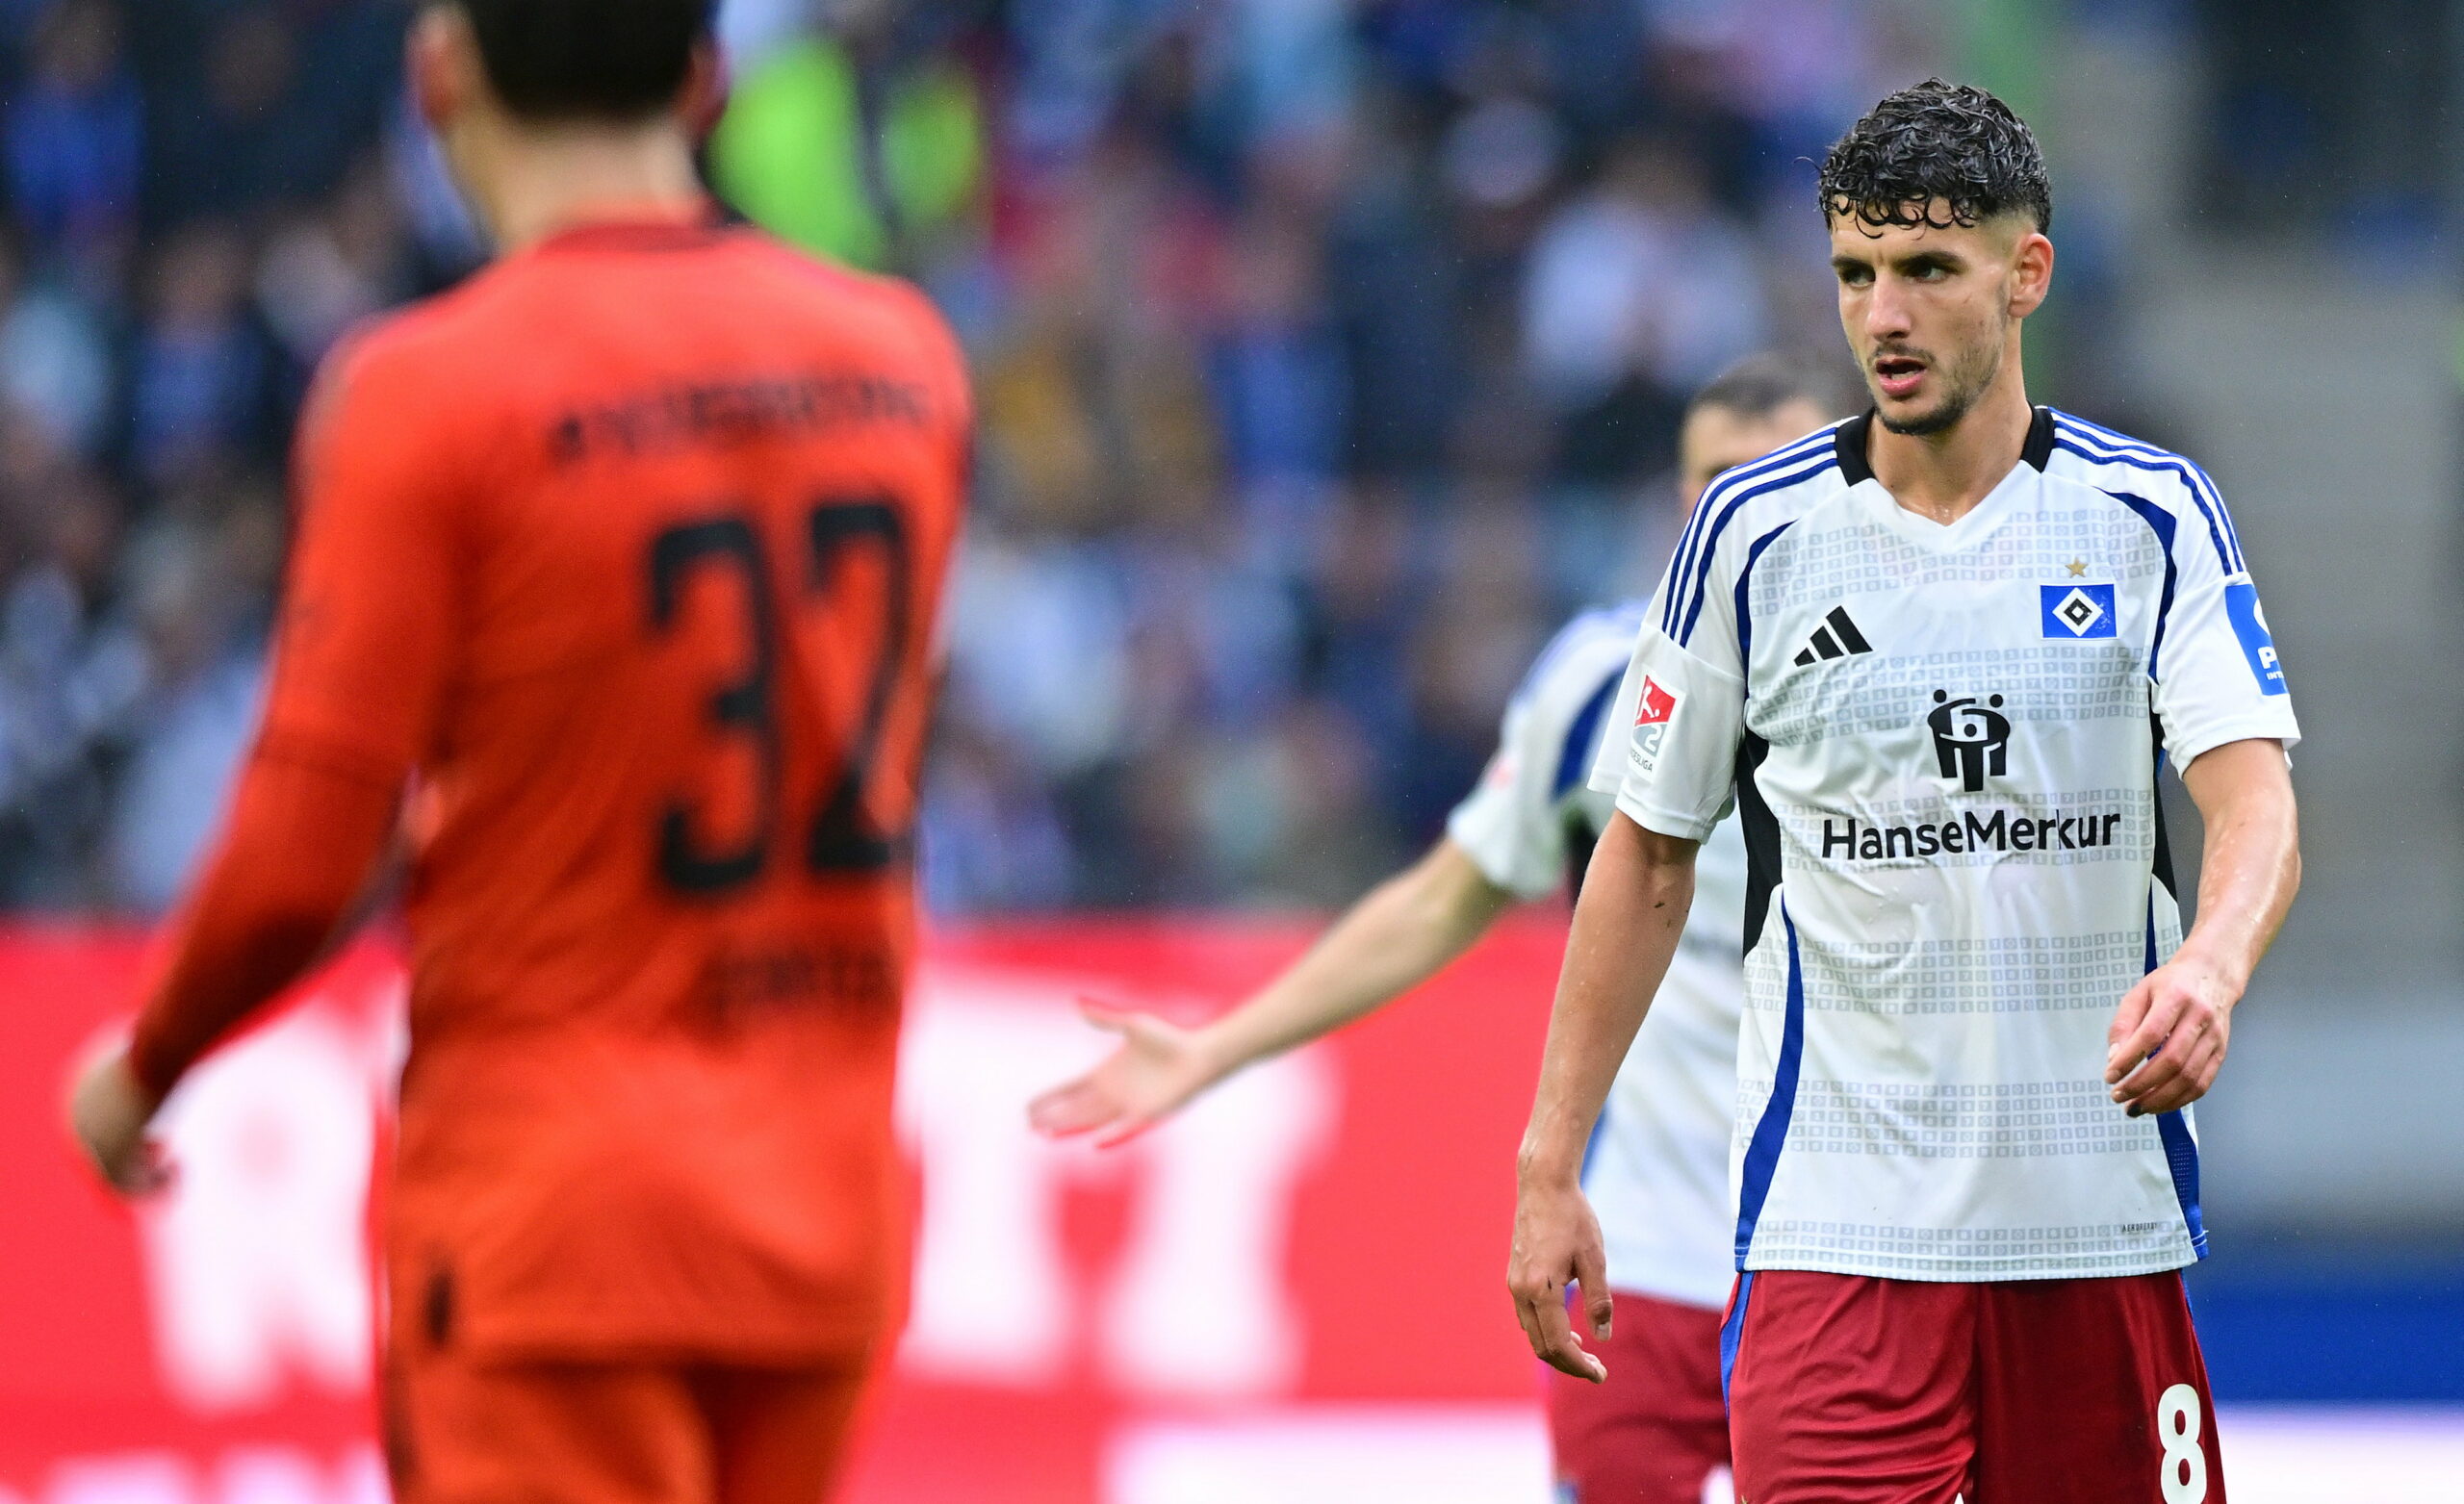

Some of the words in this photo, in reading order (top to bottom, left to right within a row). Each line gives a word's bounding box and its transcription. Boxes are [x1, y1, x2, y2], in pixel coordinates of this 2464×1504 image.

[653, 499, 910, 895] 32
[1821, 808, 2121, 861] HanseMerkur
[2157, 1383, 2208, 1504] 8
